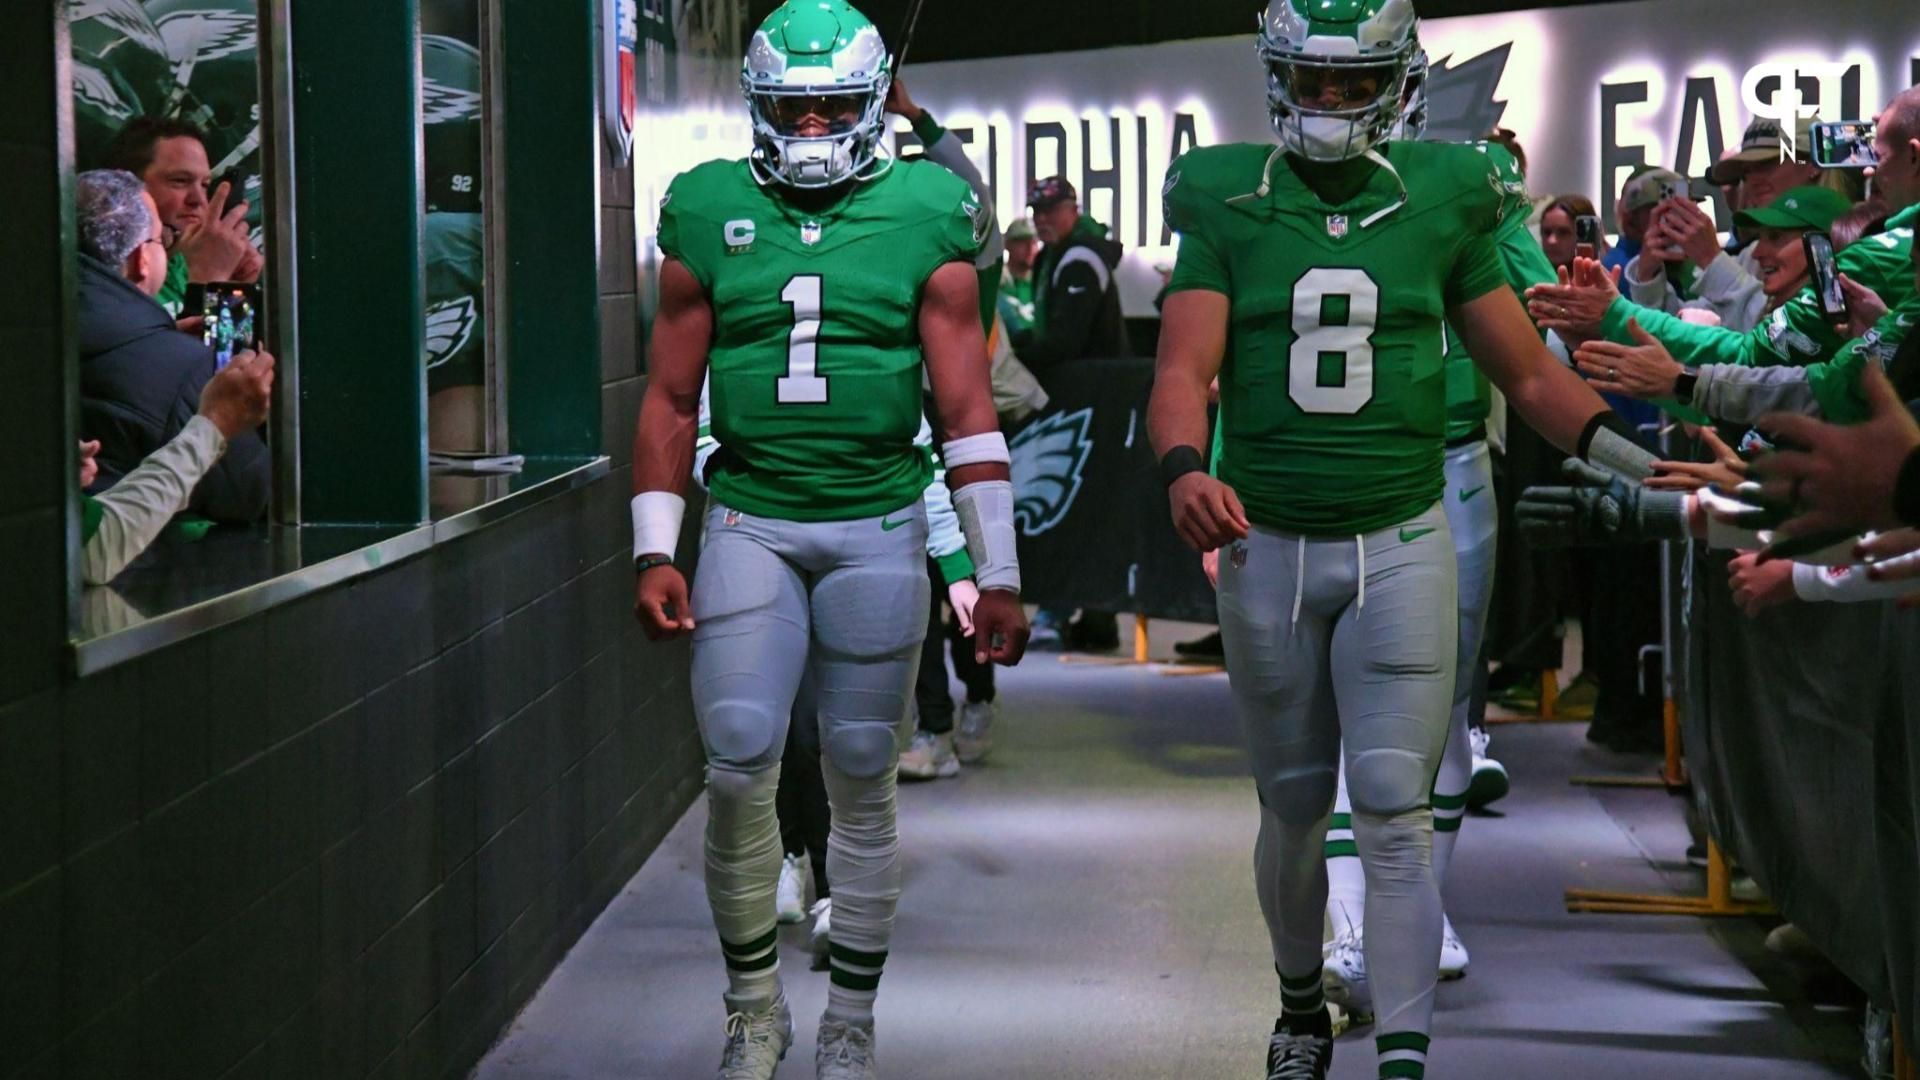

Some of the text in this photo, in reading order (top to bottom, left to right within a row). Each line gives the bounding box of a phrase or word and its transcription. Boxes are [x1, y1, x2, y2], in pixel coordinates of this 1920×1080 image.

[451, 175, 472, 192] 92
[724, 219, 755, 246] C
[776, 273, 829, 403] 1
[1286, 266, 1380, 415] 8
